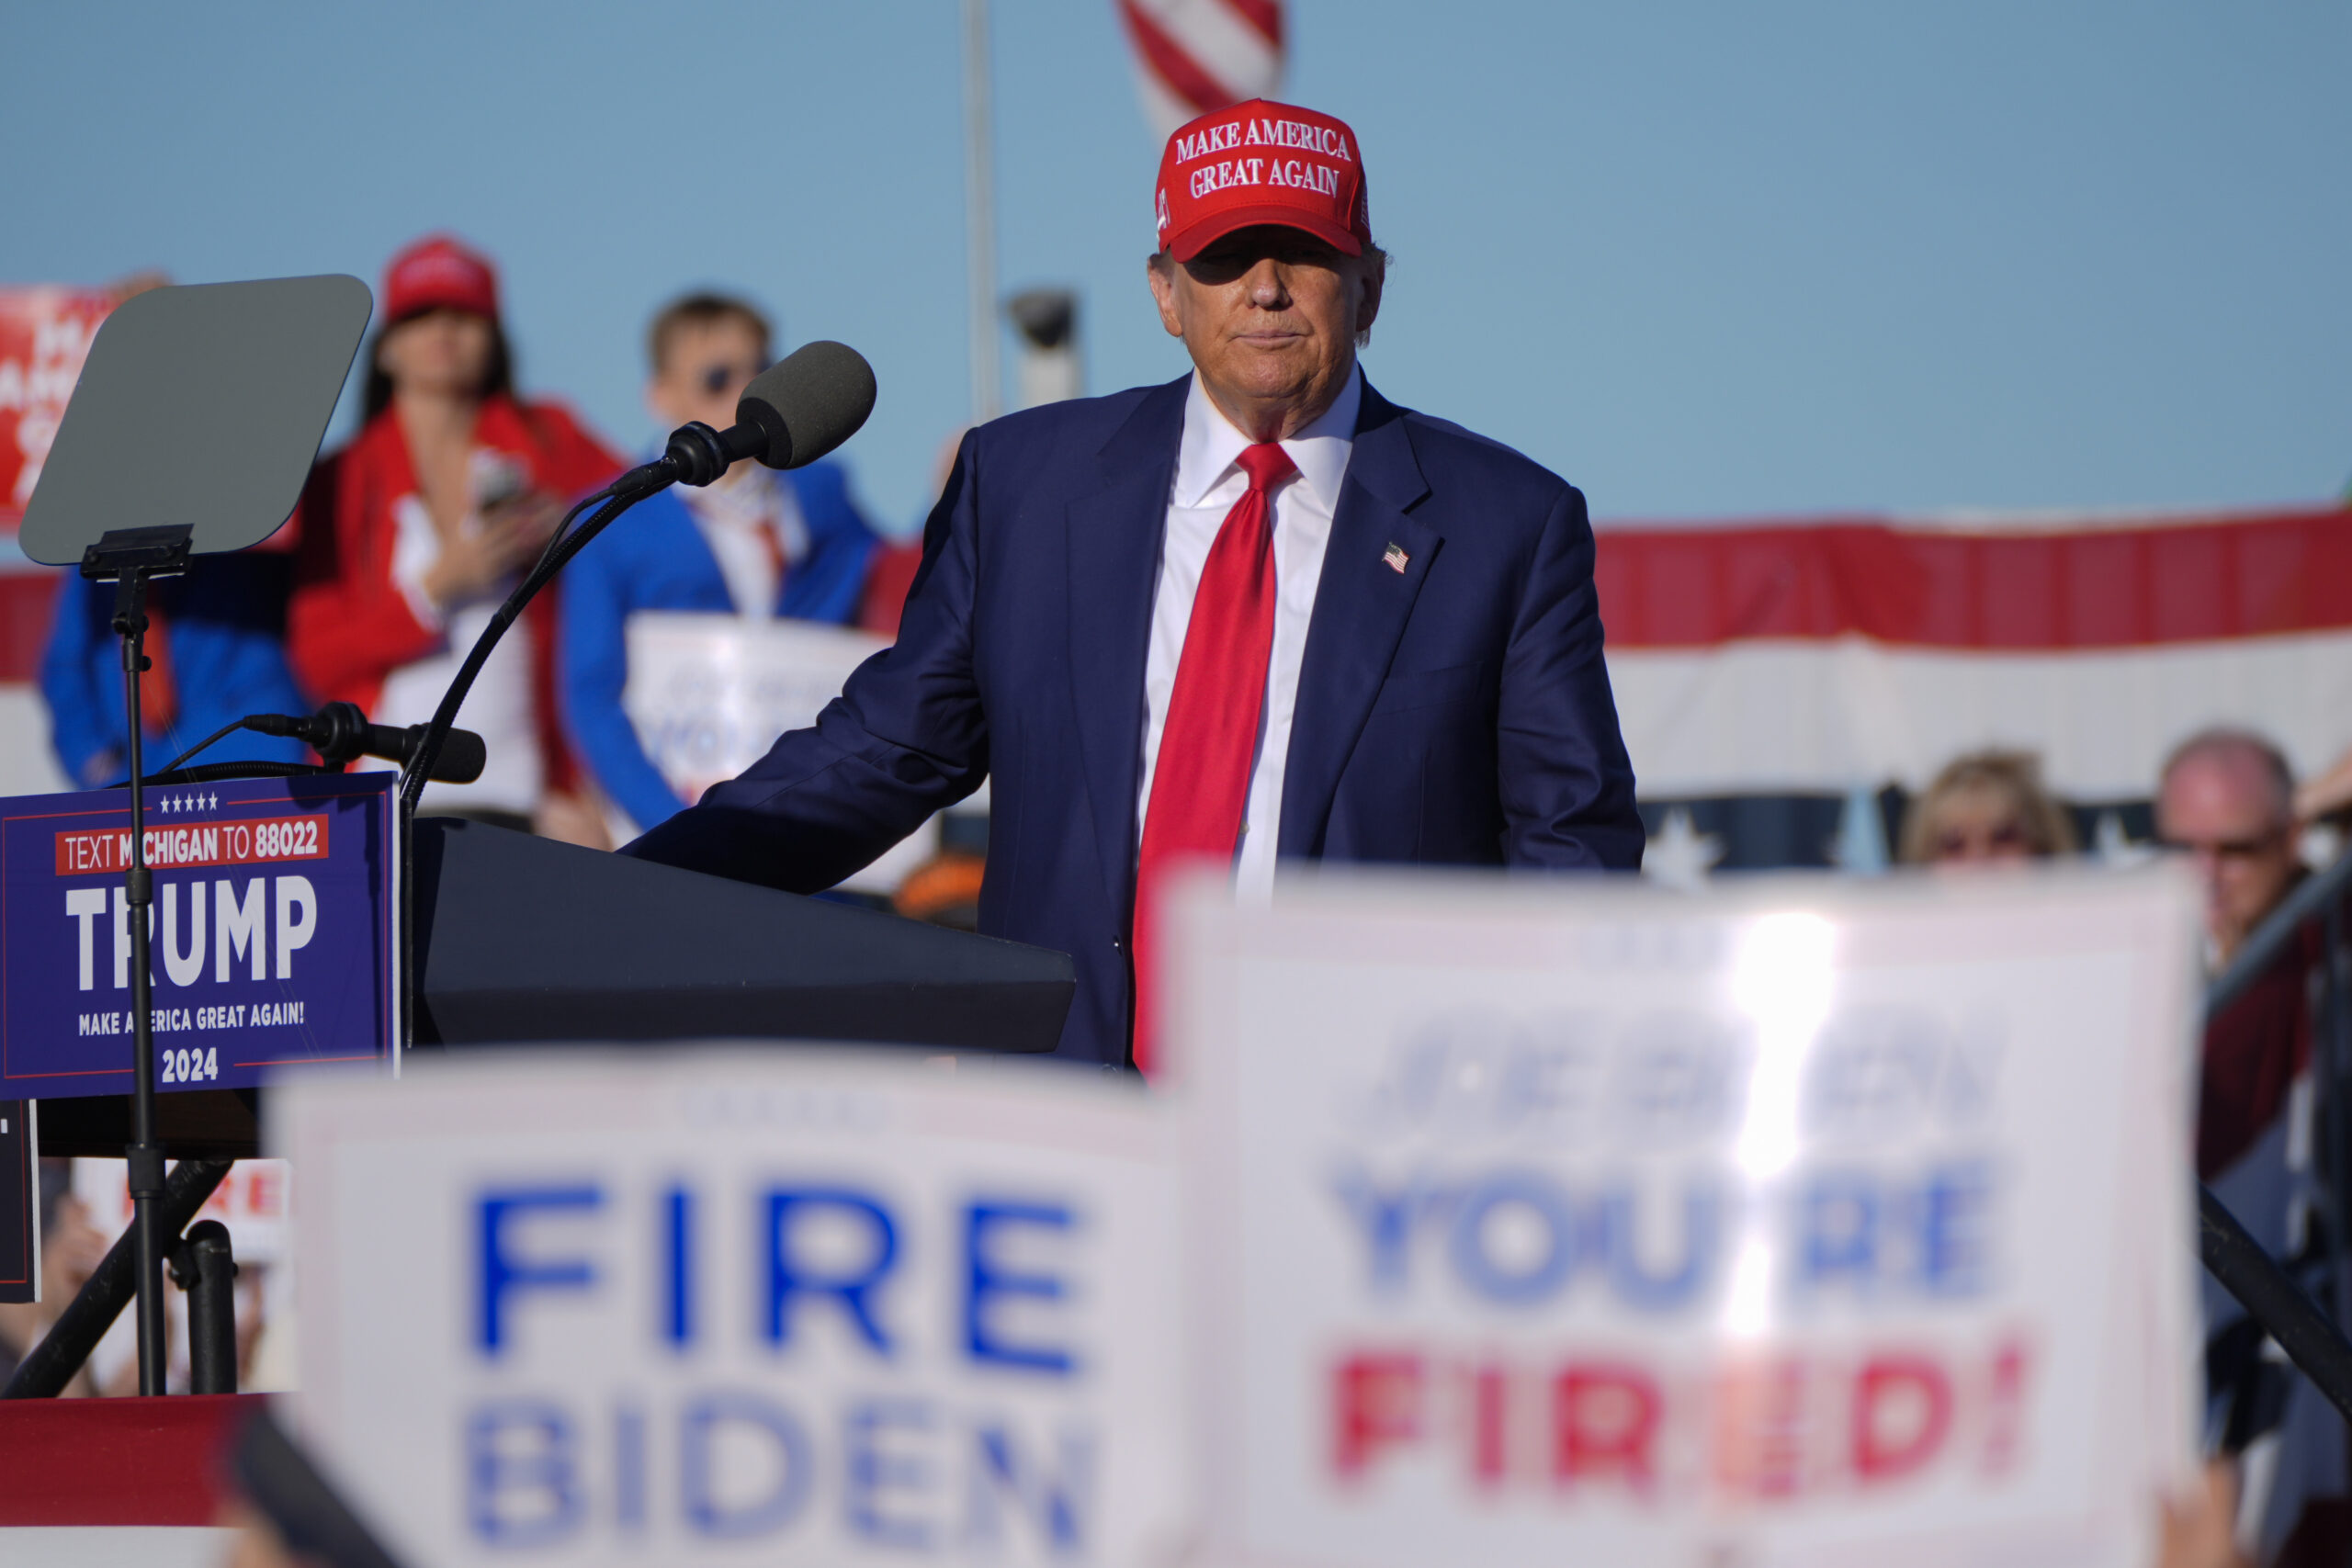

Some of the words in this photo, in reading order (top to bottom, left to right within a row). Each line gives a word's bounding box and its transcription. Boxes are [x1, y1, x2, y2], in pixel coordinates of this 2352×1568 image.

[1175, 121, 1241, 165] MAKE
[1243, 118, 1352, 162] AMERICA
[1190, 158, 1264, 199] GREAT
[1268, 158, 1340, 198] AGAIN
[65, 834, 114, 870] TEXT
[119, 827, 219, 867] MCHIGAN
[222, 825, 250, 860] TO
[254, 820, 318, 858] 88022
[78, 1011, 120, 1037] MAKE
[124, 1008, 192, 1033] AERICA
[196, 1004, 246, 1031] GREAT
[250, 1000, 305, 1027] AGAIN!
[162, 1046, 219, 1084] 2024
[467, 1176, 1082, 1378] FIRE
[462, 1389, 1101, 1552] BIDEN
